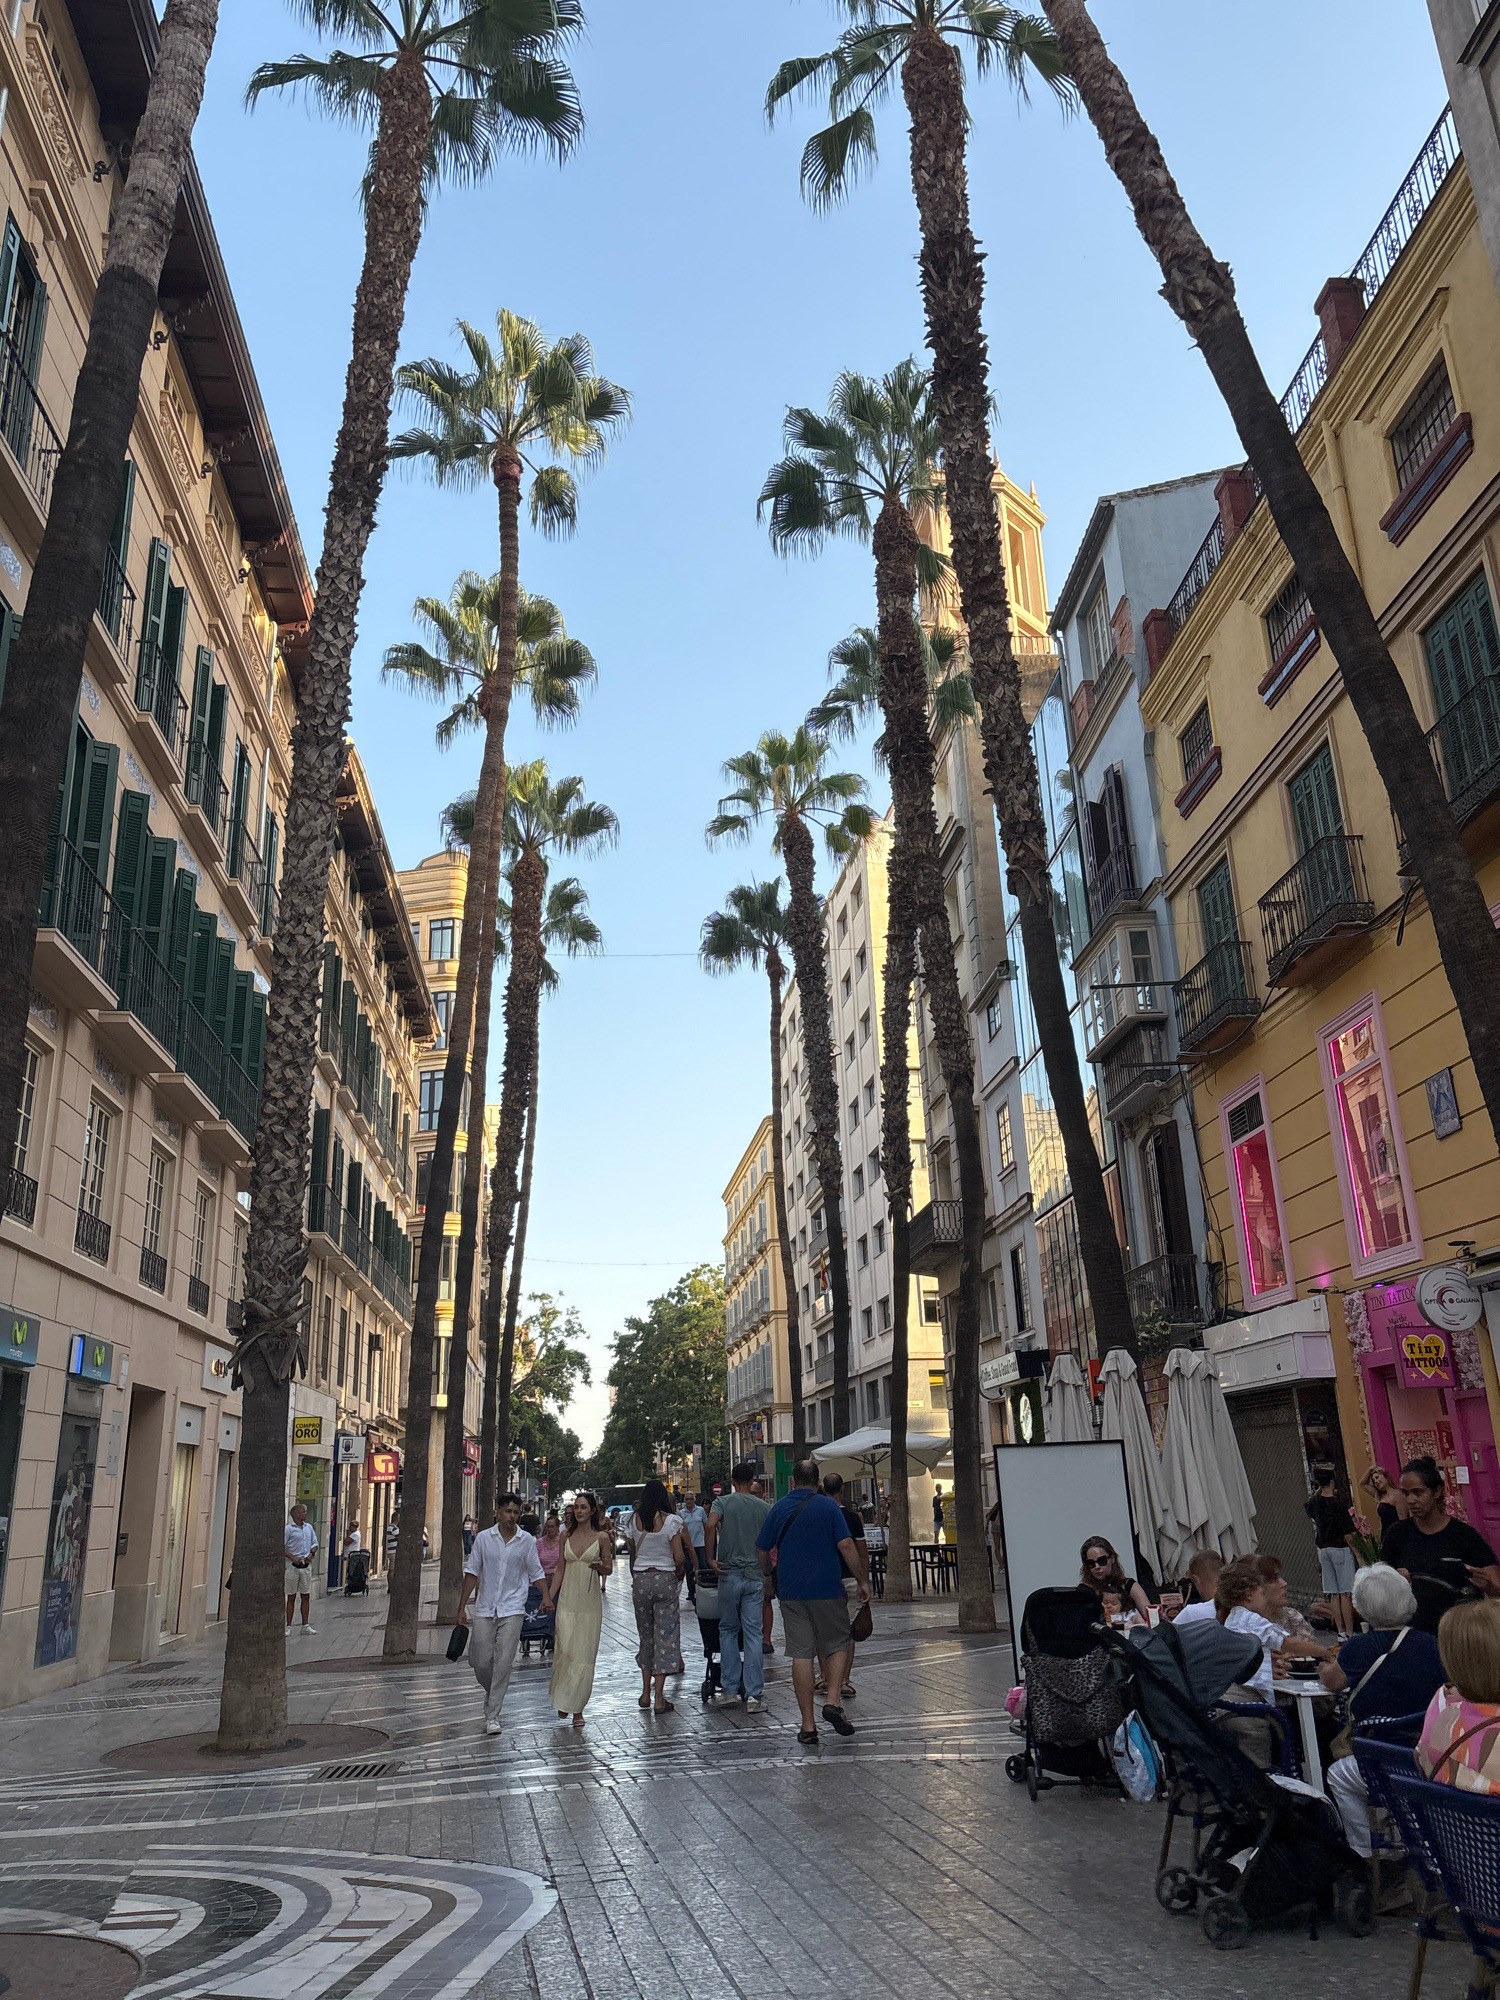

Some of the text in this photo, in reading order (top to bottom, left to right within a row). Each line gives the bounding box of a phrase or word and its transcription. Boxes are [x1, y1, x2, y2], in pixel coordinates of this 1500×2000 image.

[1370, 1294, 1386, 1309] TINY
[1407, 1343, 1441, 1356] Tiny
[1403, 1356, 1450, 1369] TATTOOS
[295, 1428, 319, 1439] ORO
